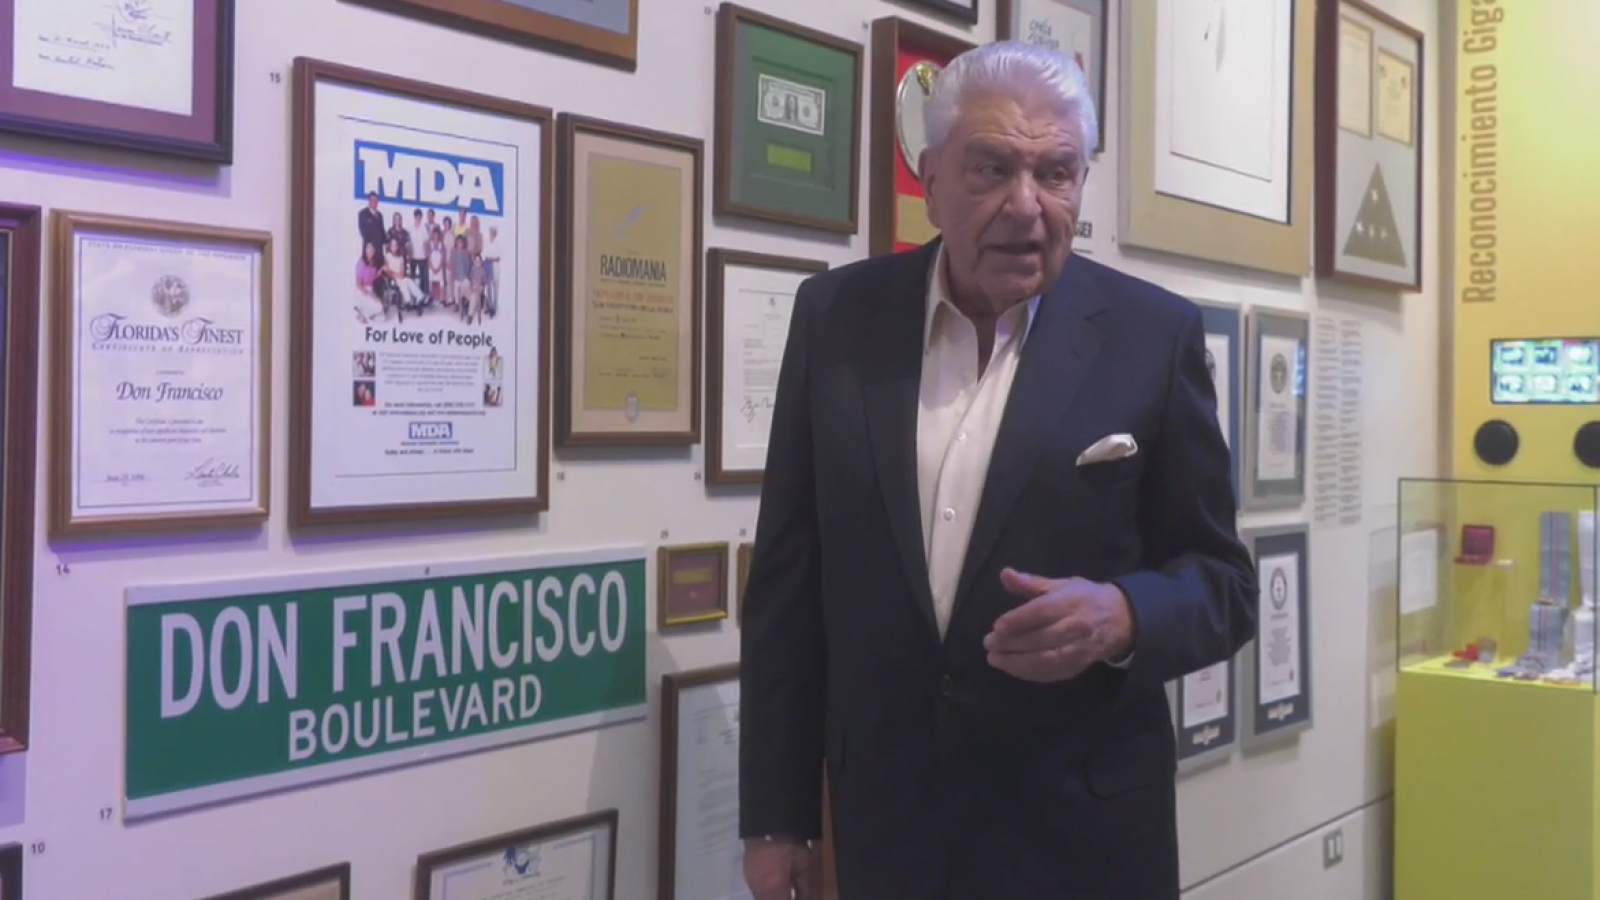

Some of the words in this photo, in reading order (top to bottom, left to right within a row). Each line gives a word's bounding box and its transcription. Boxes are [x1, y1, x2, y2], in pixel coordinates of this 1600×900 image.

[1462, 0, 1504, 54] Gig
[269, 72, 281, 84] 15
[358, 146, 500, 212] MDA
[1461, 64, 1497, 304] Reconocimiento
[600, 255, 667, 282] RADIOMANIA
[365, 326, 389, 343] For
[392, 327, 424, 344] Love
[428, 330, 444, 346] of
[447, 331, 493, 349] People
[116, 381, 151, 401] Don
[156, 383, 224, 403] Francisco
[411, 424, 450, 438] MDA
[160, 601, 298, 720] DON
[332, 570, 628, 693] FRANCISCO
[288, 674, 542, 762] BOULEVARD
[100, 807, 113, 820] 17
[31, 841, 45, 854] 10
